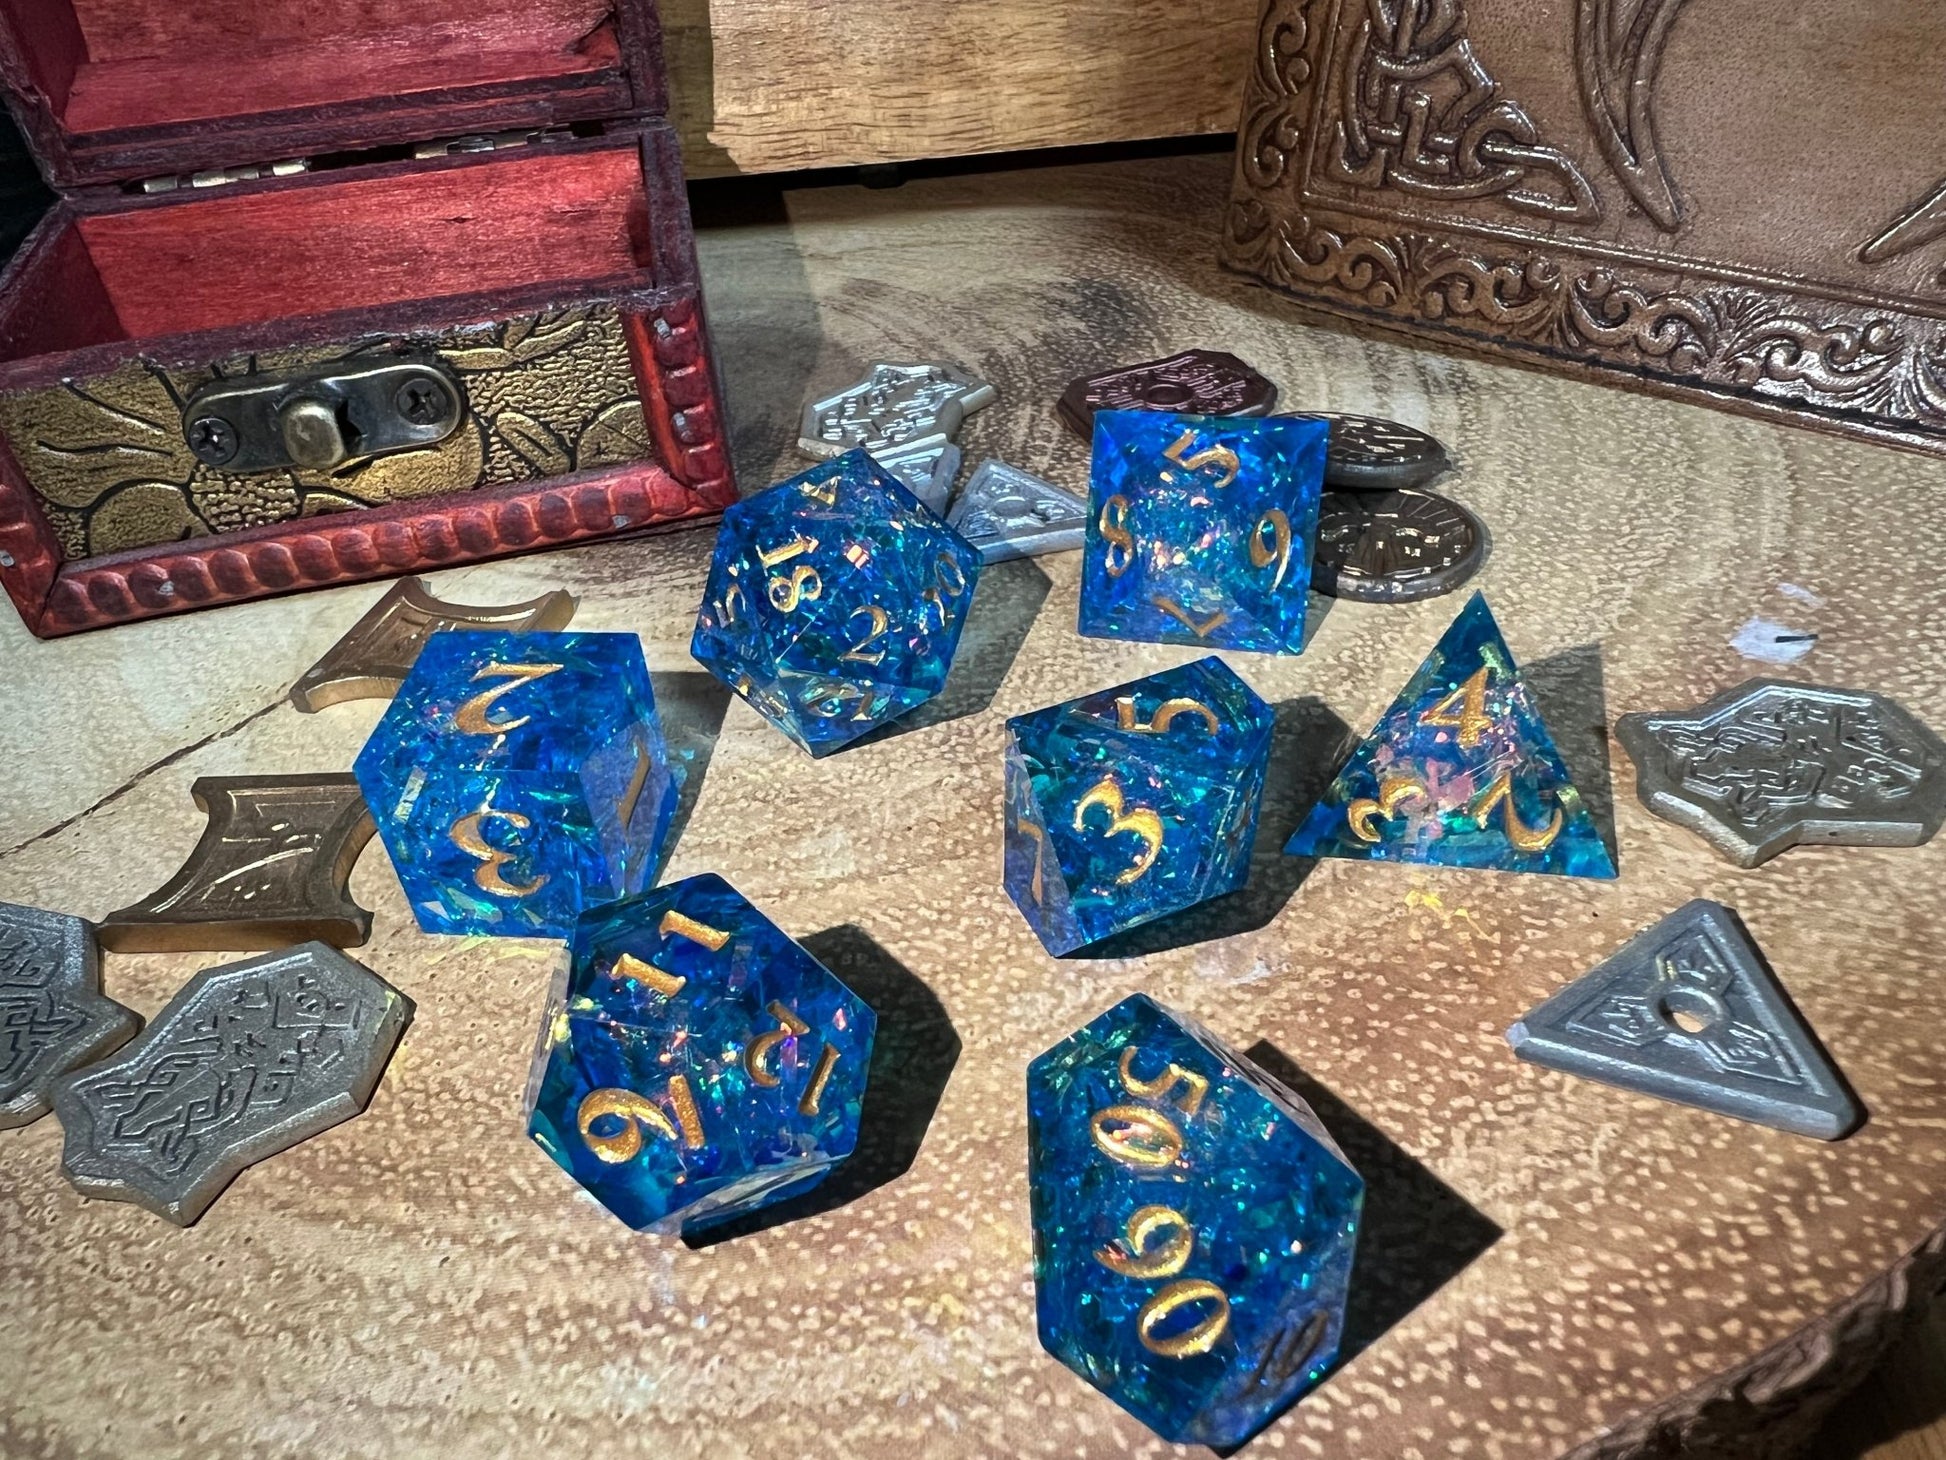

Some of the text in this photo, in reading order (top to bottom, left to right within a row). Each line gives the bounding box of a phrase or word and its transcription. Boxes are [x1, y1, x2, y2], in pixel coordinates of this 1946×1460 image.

[1163, 431, 1239, 488] 5
[754, 536, 823, 613] 18
[1099, 494, 1134, 578] 8
[836, 604, 887, 667] 2
[455, 663, 565, 734] 2
[1114, 697, 1219, 736] 5
[1418, 667, 1492, 748] 4
[1074, 776, 1164, 884] 3
[1347, 776, 1427, 843] 3
[1472, 772, 1563, 851] 2
[450, 809, 551, 897] 3
[608, 909, 730, 999] 11
[1090, 1046, 1208, 1169] 50
